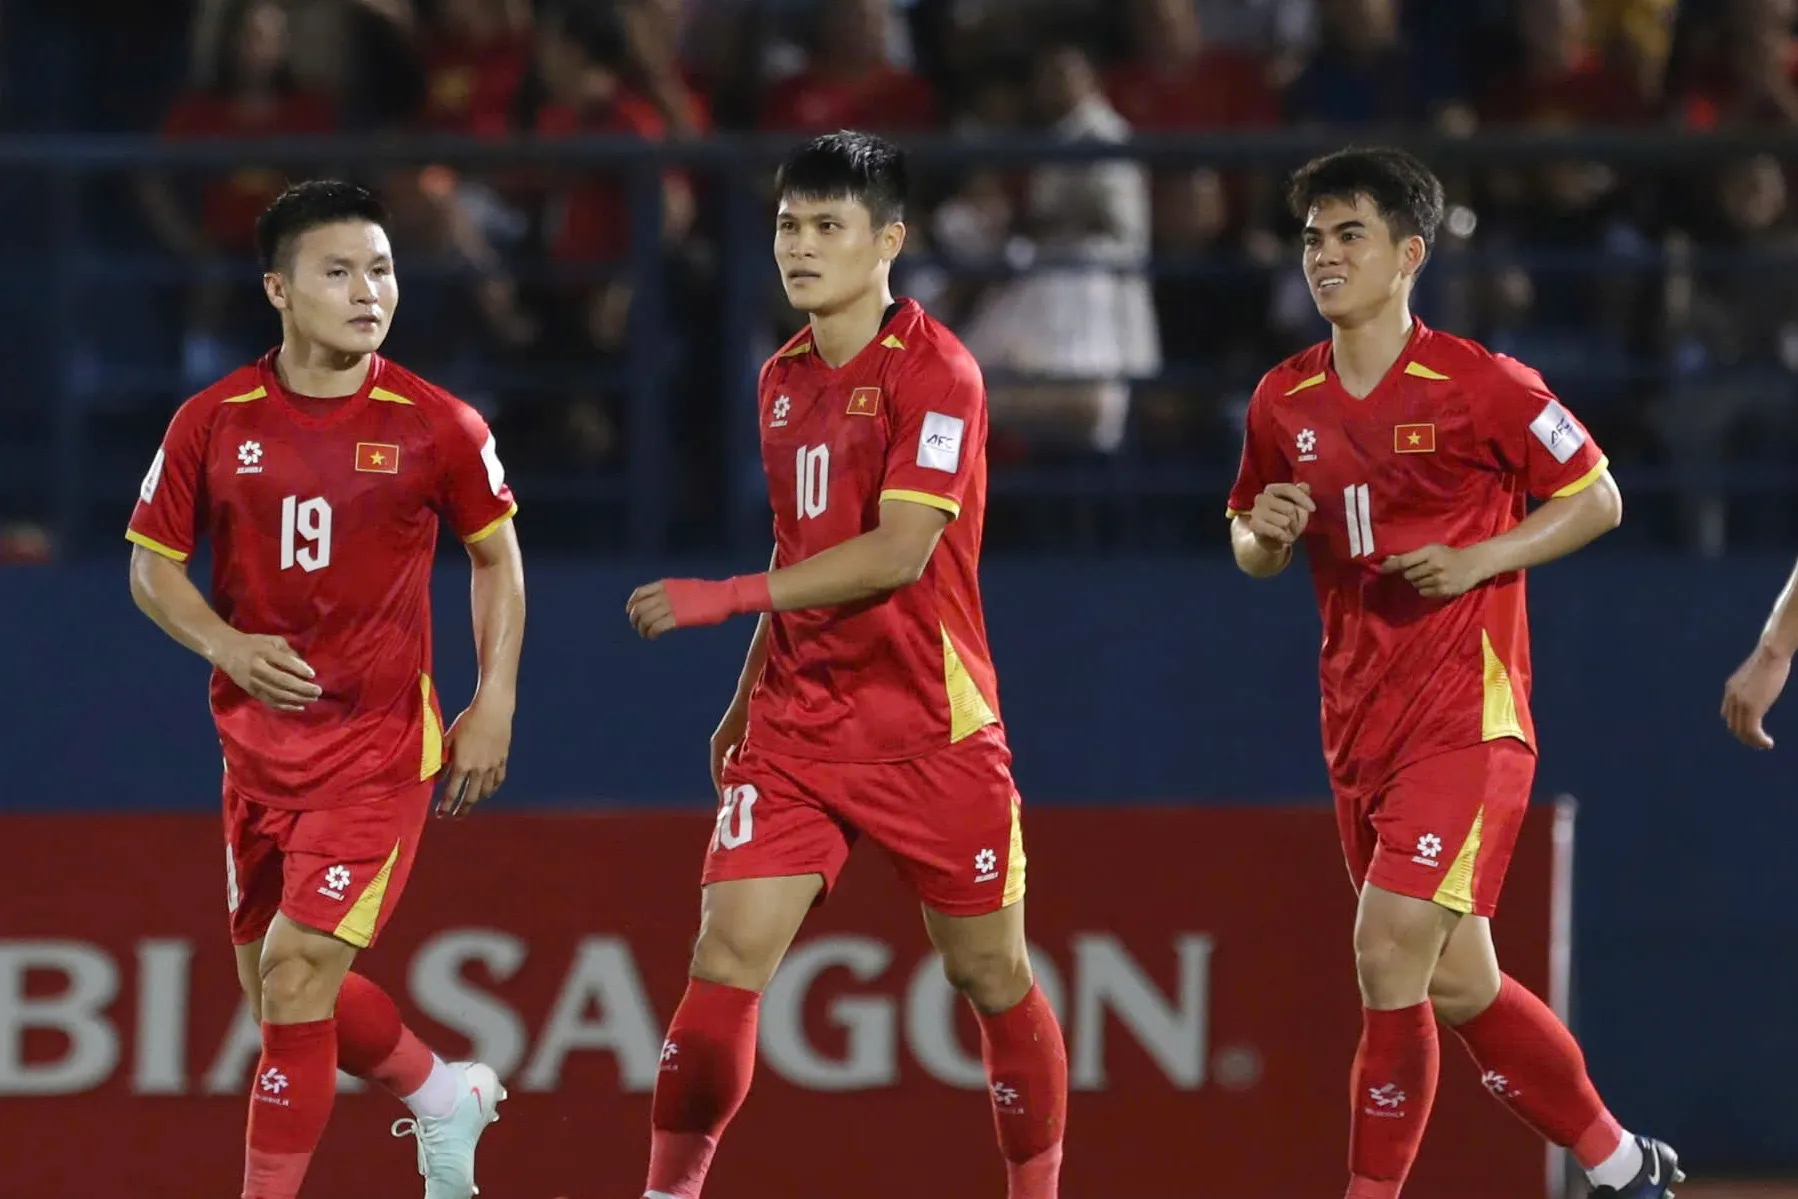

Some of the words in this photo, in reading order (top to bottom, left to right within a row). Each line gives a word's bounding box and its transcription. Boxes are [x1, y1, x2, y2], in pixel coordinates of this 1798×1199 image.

[796, 443, 830, 521] 10
[1343, 483, 1375, 558] 11
[280, 495, 333, 573] 19
[712, 784, 759, 853] 10
[404, 928, 1212, 1095] SAGON
